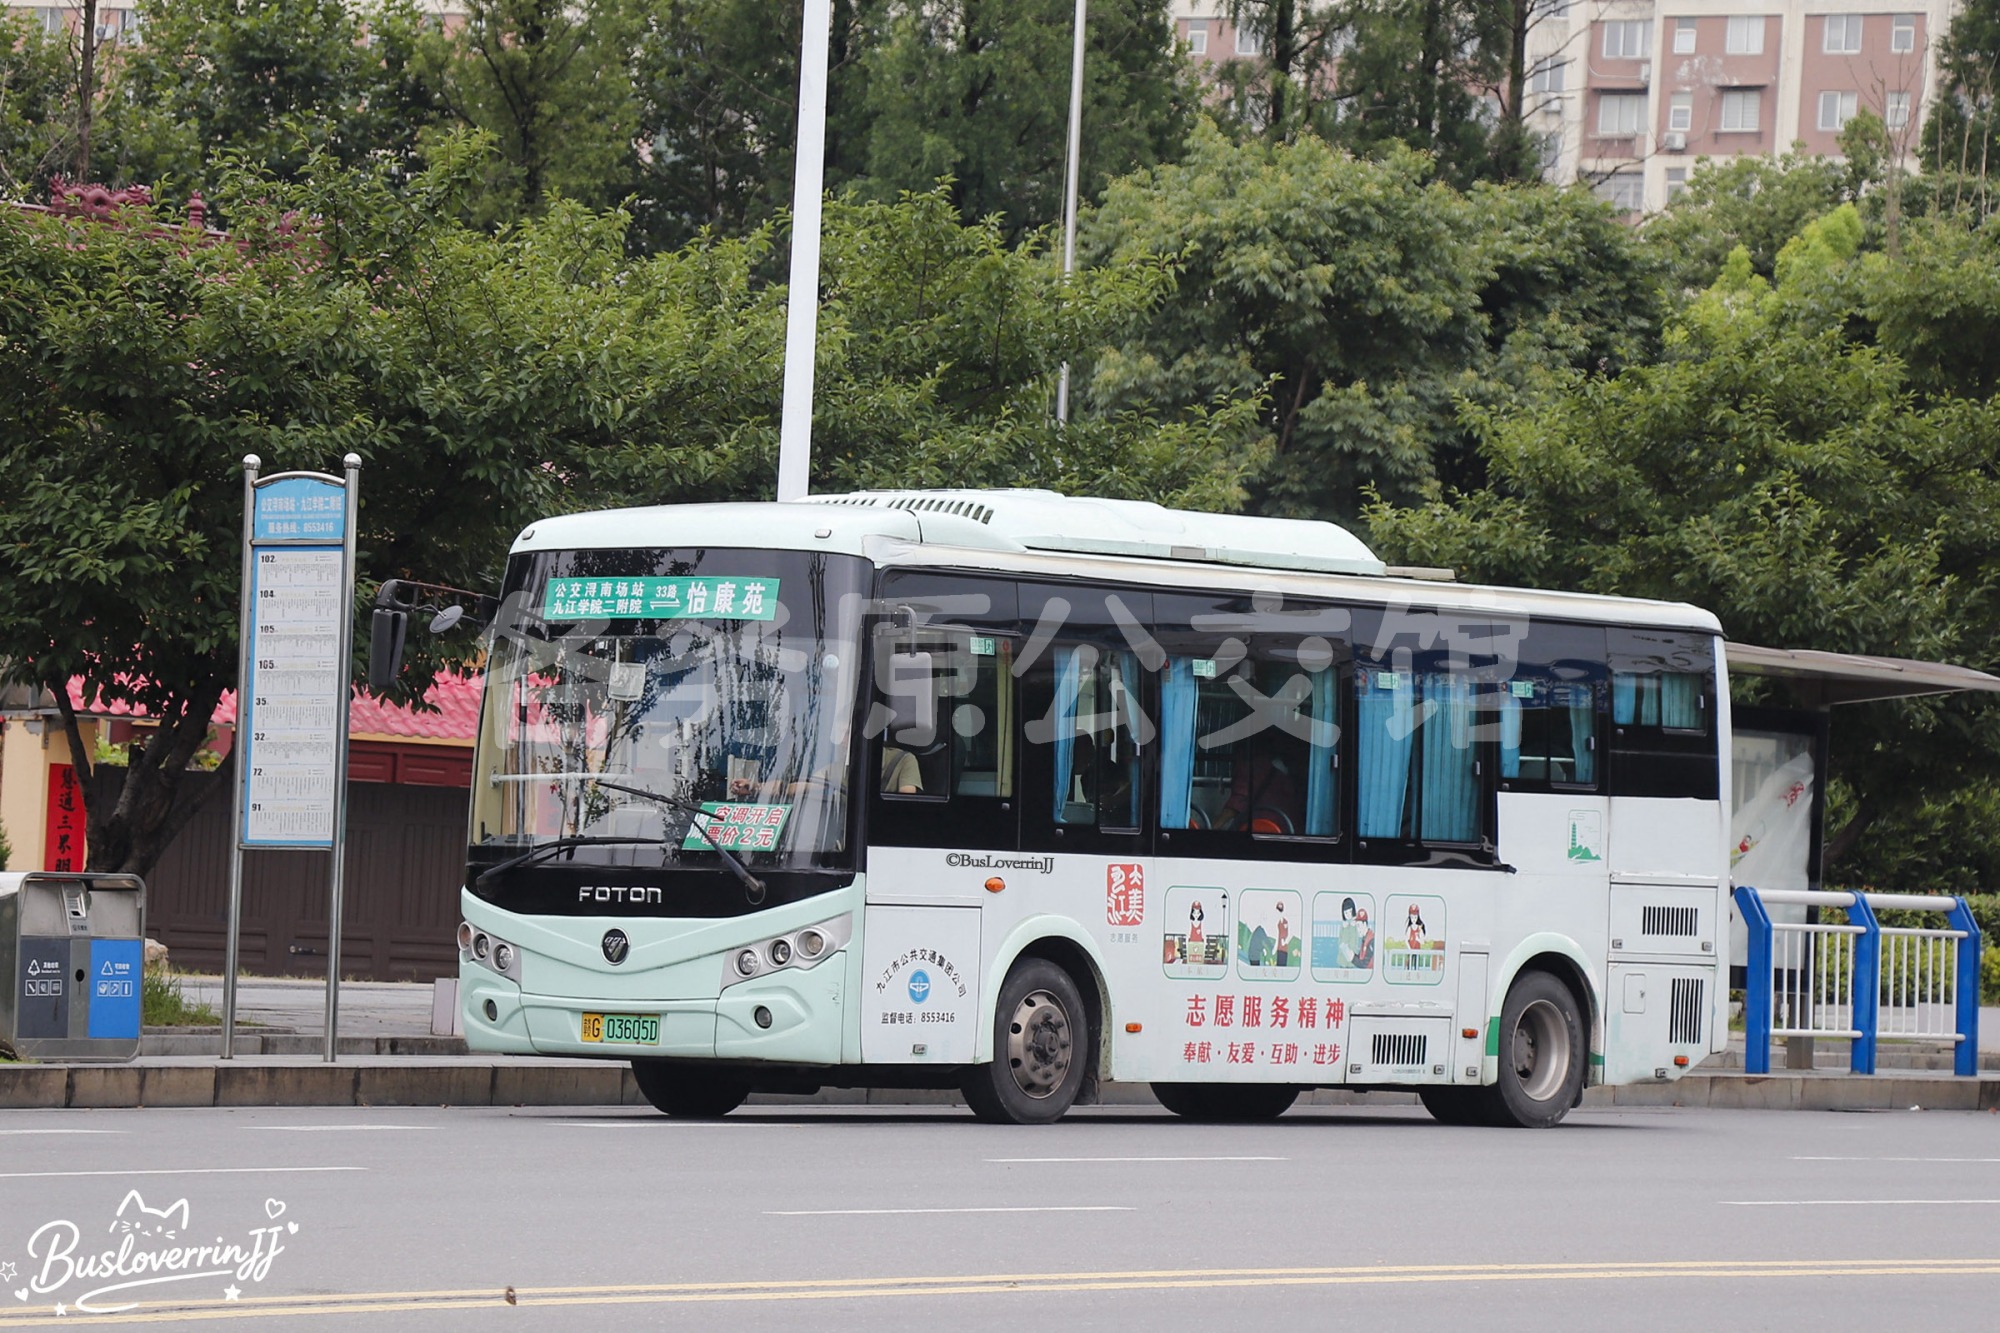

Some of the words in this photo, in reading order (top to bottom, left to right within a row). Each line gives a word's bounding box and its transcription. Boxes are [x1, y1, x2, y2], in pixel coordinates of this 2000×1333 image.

[261, 555, 275, 563] 102
[260, 590, 274, 598] 104
[555, 582, 645, 598] 公交浔南场站
[656, 585, 678, 599] 33路
[687, 581, 766, 615] 怡康苑
[552, 598, 642, 615] 九江学院二附院
[256, 697, 267, 706] 35
[254, 733, 265, 741] 32
[253, 768, 263, 776] 72
[252, 803, 262, 812] 91
[711, 806, 785, 826] 空调开启
[702, 826, 774, 847] 票价2元
[579, 886, 662, 903] FOTON
[876, 948, 967, 998] 九江市公共交通集团公司
[1185, 994, 1345, 1029] 志愿服务精神
